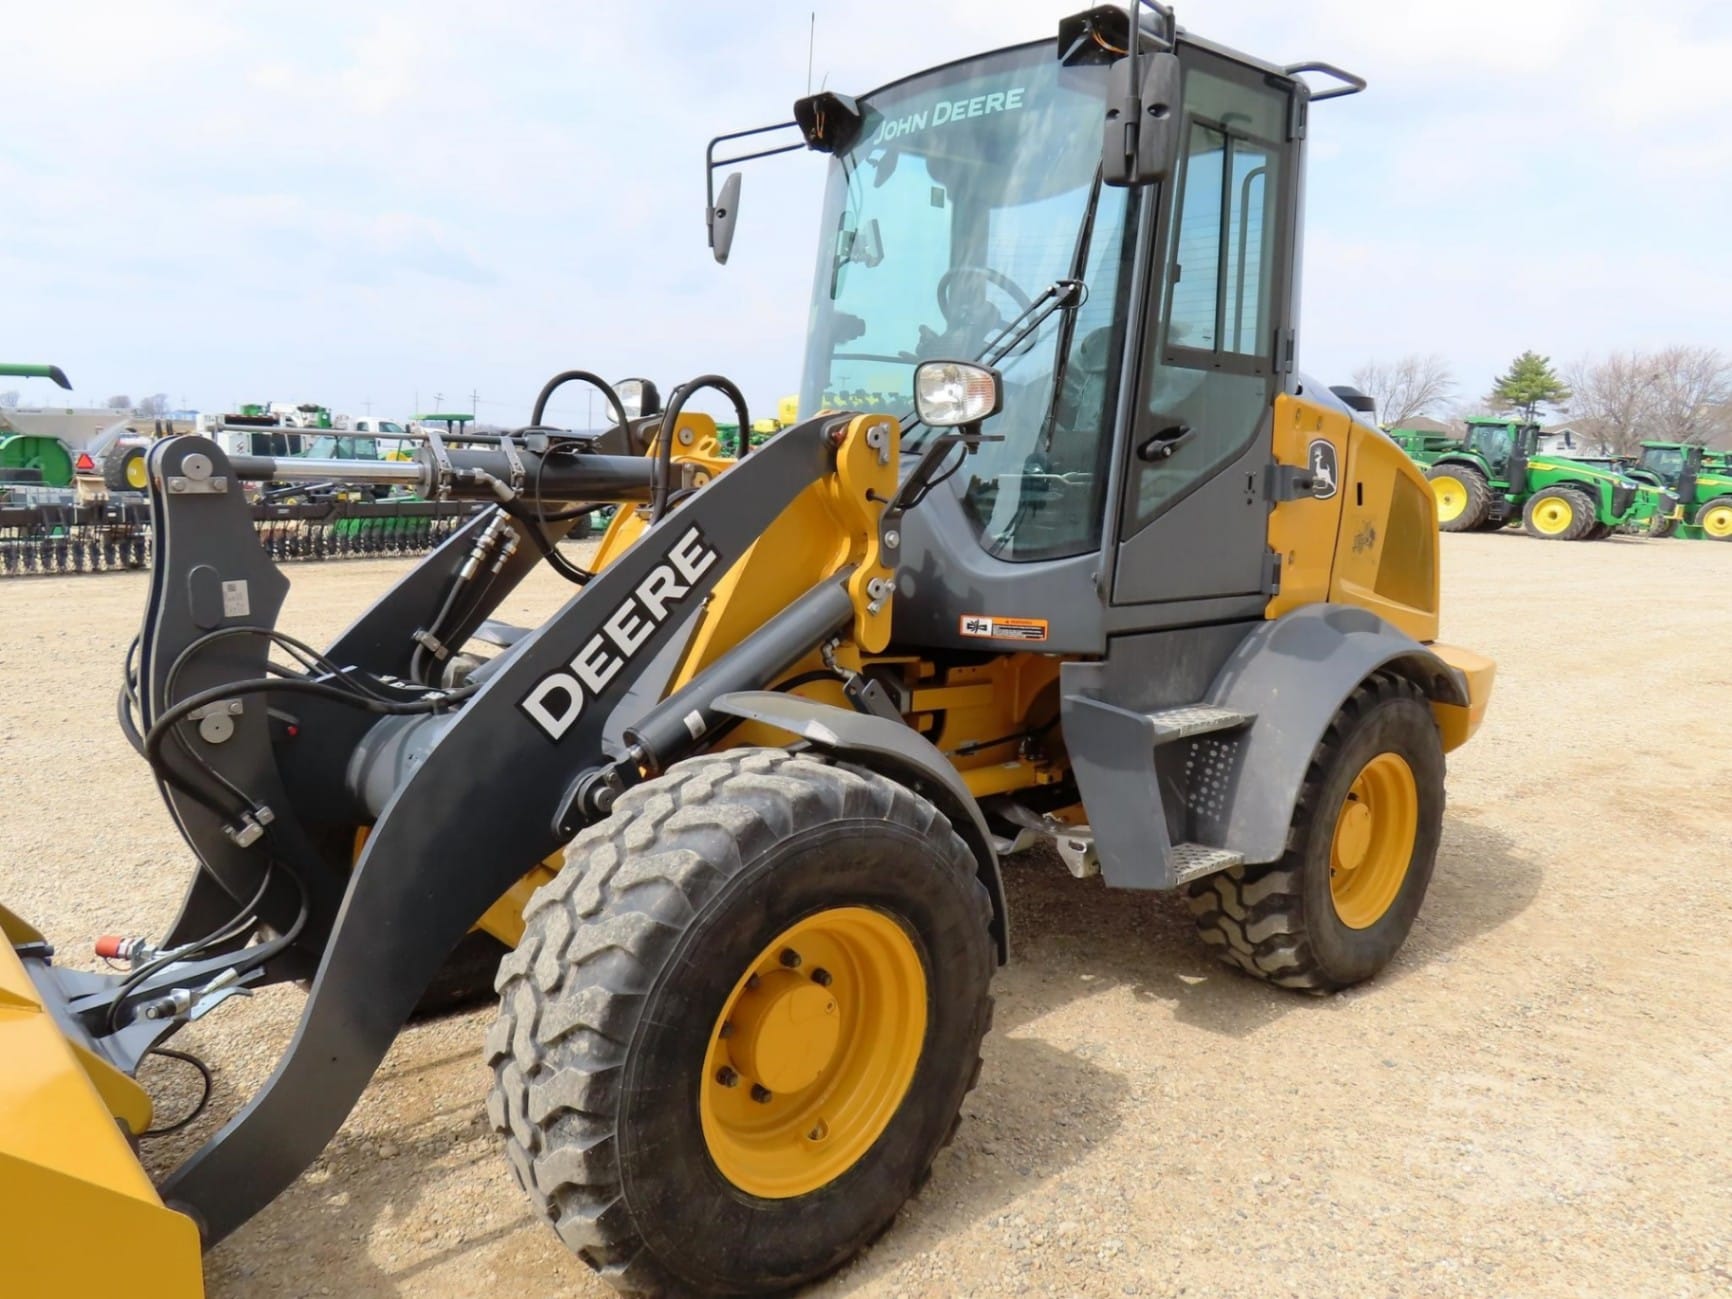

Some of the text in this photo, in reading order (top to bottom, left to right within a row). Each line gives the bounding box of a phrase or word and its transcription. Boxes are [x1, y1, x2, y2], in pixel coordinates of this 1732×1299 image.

[873, 87, 1025, 145] JOHN DEERE
[521, 526, 718, 741] DEERE
